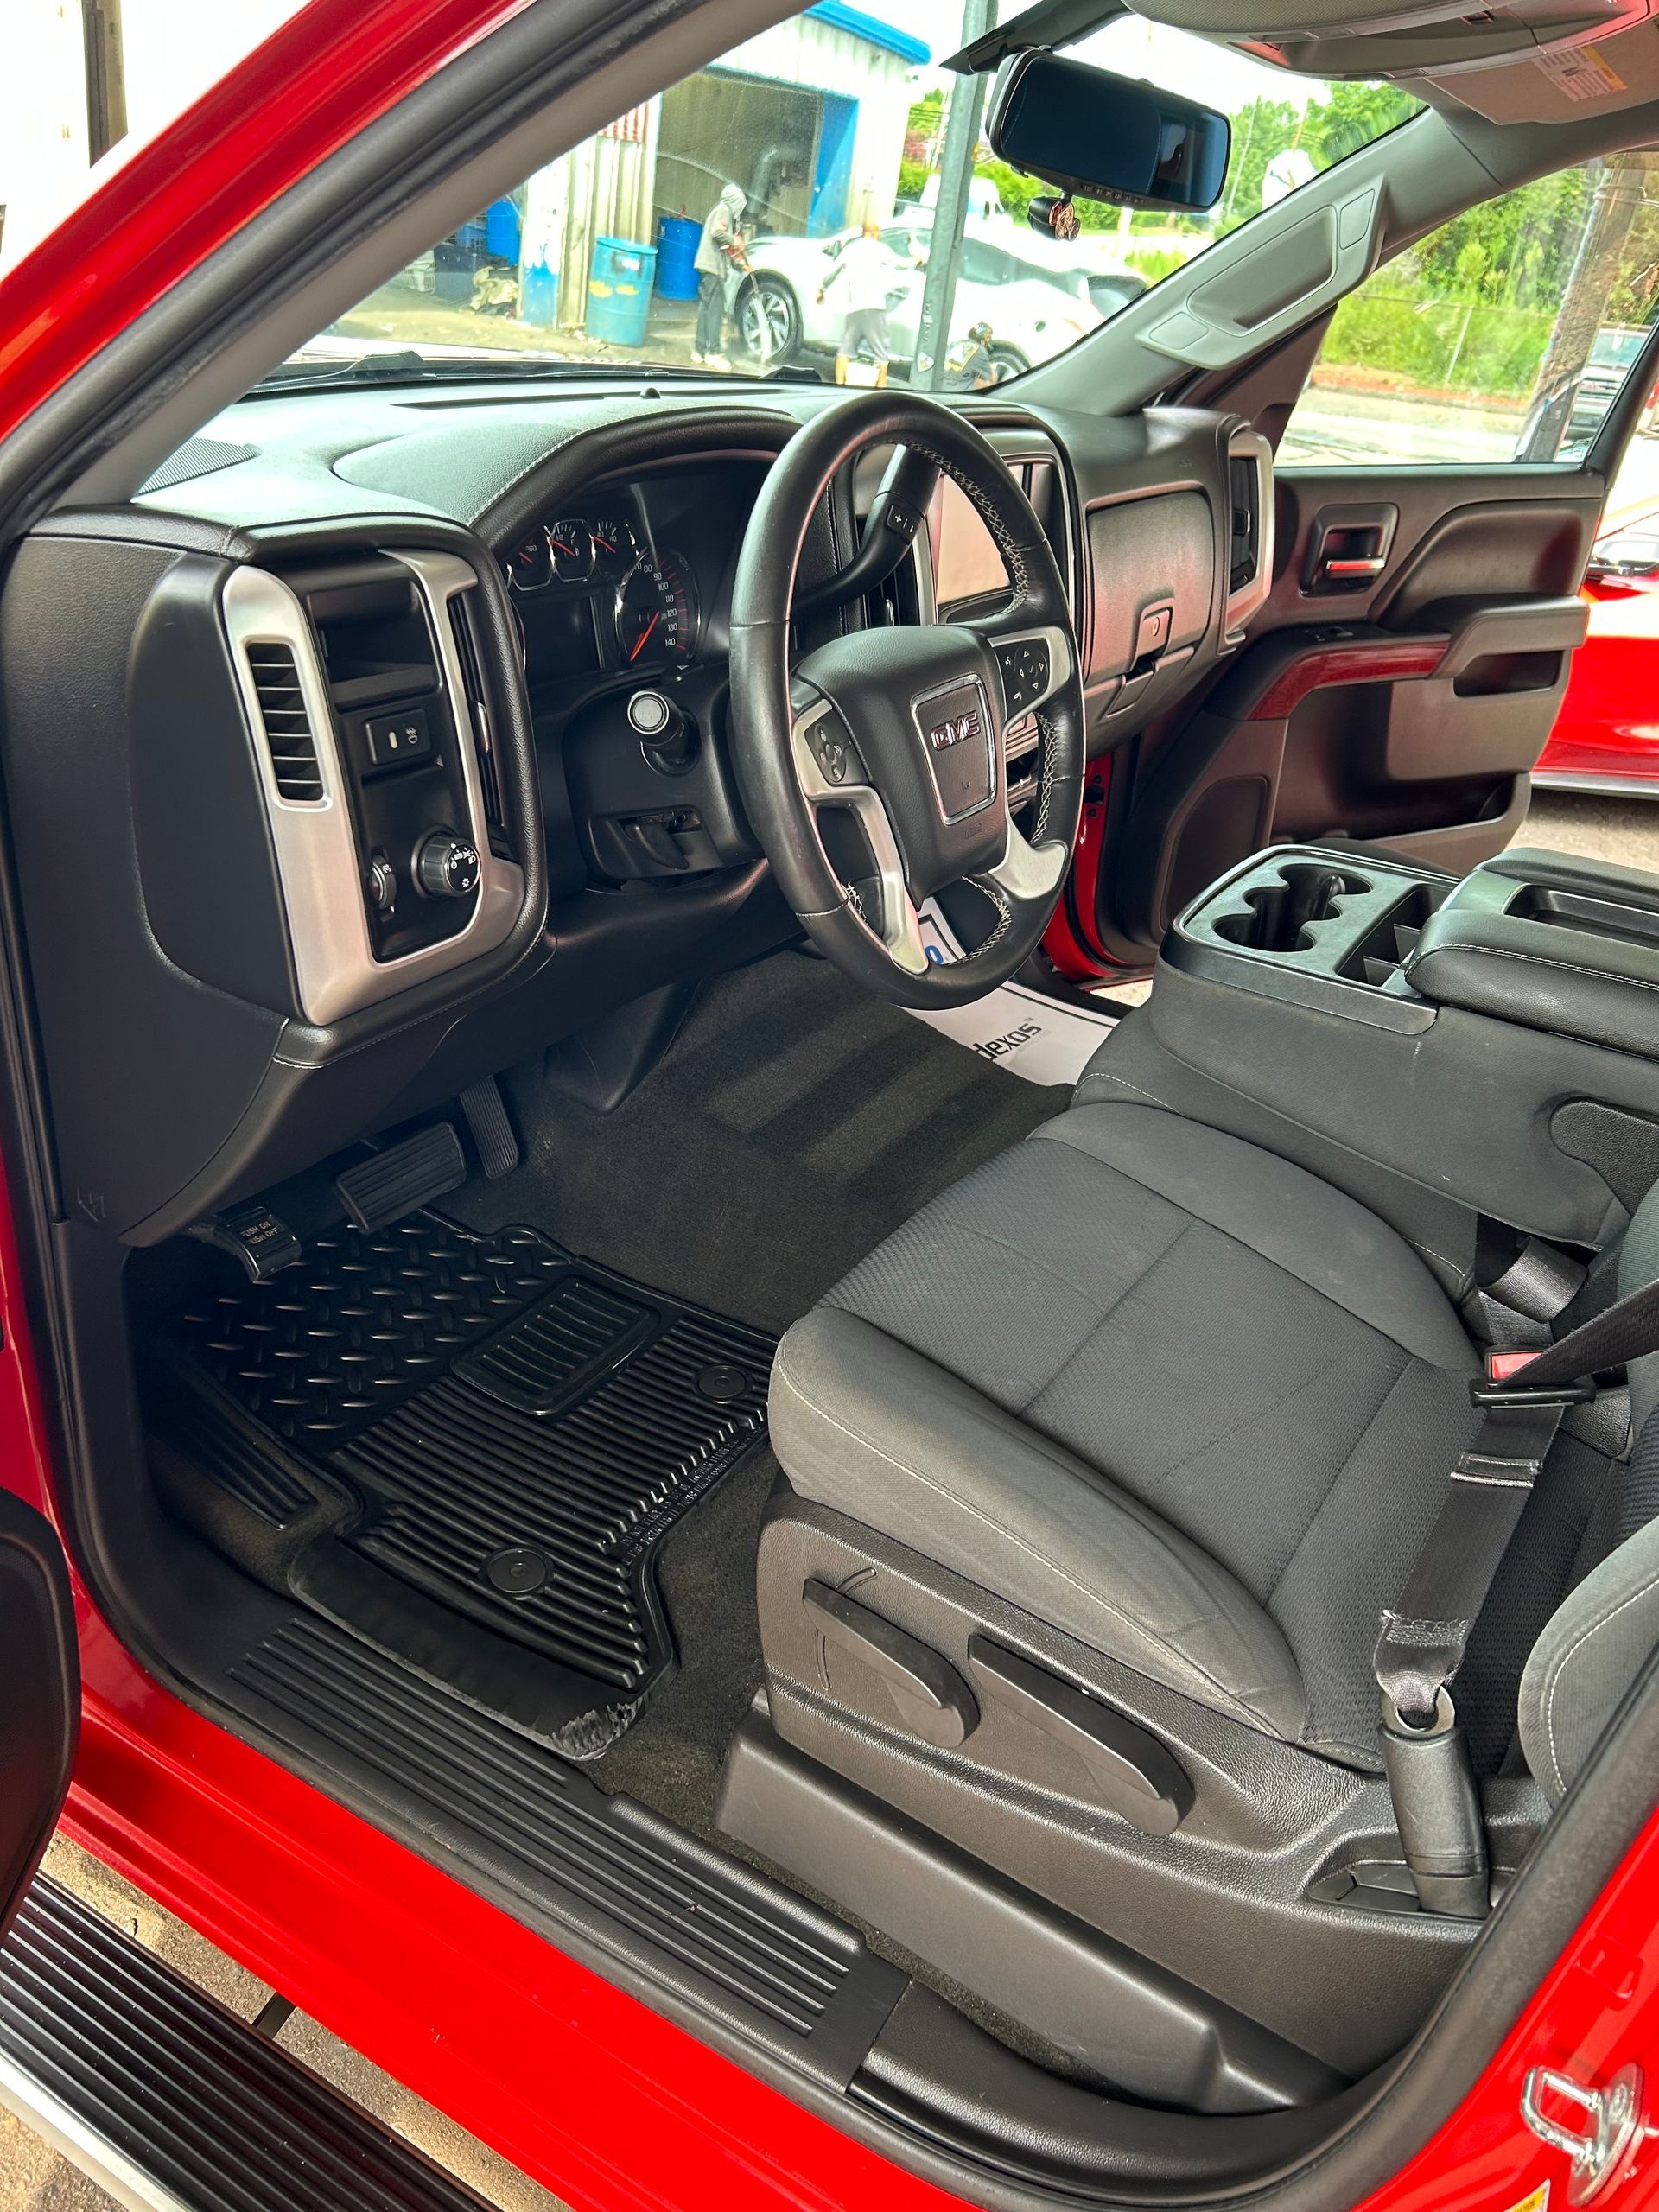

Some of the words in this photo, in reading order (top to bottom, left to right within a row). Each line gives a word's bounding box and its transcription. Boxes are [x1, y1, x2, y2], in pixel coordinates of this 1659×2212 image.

[643, 564, 652, 573] 80
[653, 572, 662, 581] 90
[658, 582, 669, 591] 100
[665, 594, 674, 603] 110
[666, 607, 677, 617] 120
[667, 622, 677, 632] 130
[664, 638, 676, 646] 140
[931, 710, 980, 750] GMC
[973, 1023, 1042, 1060] dexos
[259, 1221, 271, 1230] ON
[264, 1227, 278, 1237] OFF
